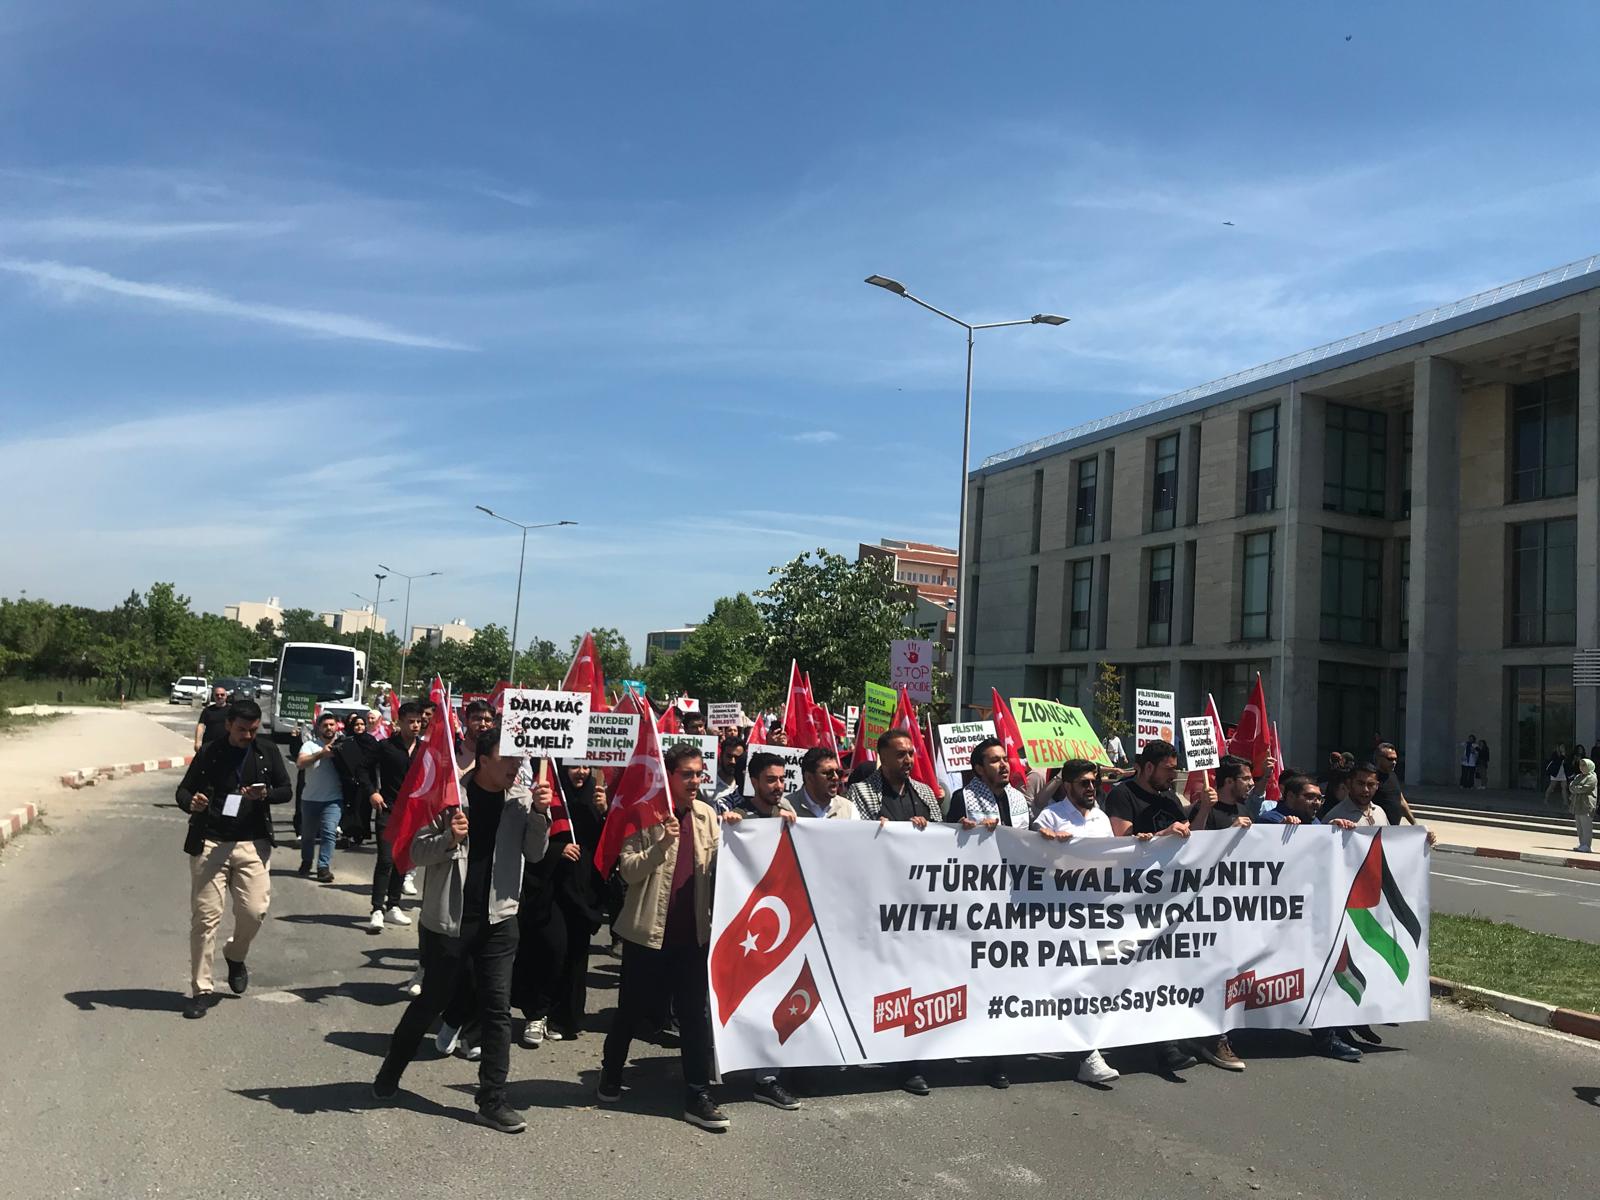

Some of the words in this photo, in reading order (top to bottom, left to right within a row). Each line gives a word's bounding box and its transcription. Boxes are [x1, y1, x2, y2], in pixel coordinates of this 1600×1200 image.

[894, 665, 930, 680] STOP
[509, 697, 553, 712] DAHA
[555, 699, 584, 716] KAÇ
[1138, 699, 1160, 708] İŞGALE
[589, 714, 633, 726] KİYEDEKİ
[1018, 701, 1081, 728] ZIONISM
[1138, 709, 1171, 718] SOYKIRIMA
[588, 726, 629, 737] RENCİLER
[951, 723, 984, 735] FİLİSTİN
[1053, 726, 1065, 737] IS
[1138, 725, 1160, 736] DUR
[514, 733, 574, 749] ÖLMELİ?
[587, 738, 611, 748] STİN
[612, 737, 634, 750] İÇİN
[943, 734, 968, 745] ÖZGÜR
[585, 750, 626, 763] RLEŞTİ!
[950, 745, 967, 756] TÜM
[1027, 738, 1110, 764] TERRORISM
[909, 858, 1046, 892] "TÜRKİYE
[1054, 866, 1164, 893] WALKS
[1170, 868, 1202, 893] IN
[879, 903, 958, 931] WITH
[967, 902, 1125, 931] CAMPUSES
[970, 941, 1029, 969] FOR
[1227, 973, 1255, 1003] #SAY
[1255, 973, 1301, 1005] STOP!
[988, 984, 1205, 1021] #CampusesSayStop
[876, 995, 911, 1024] #SAY
[913, 991, 964, 1029] STOP!
